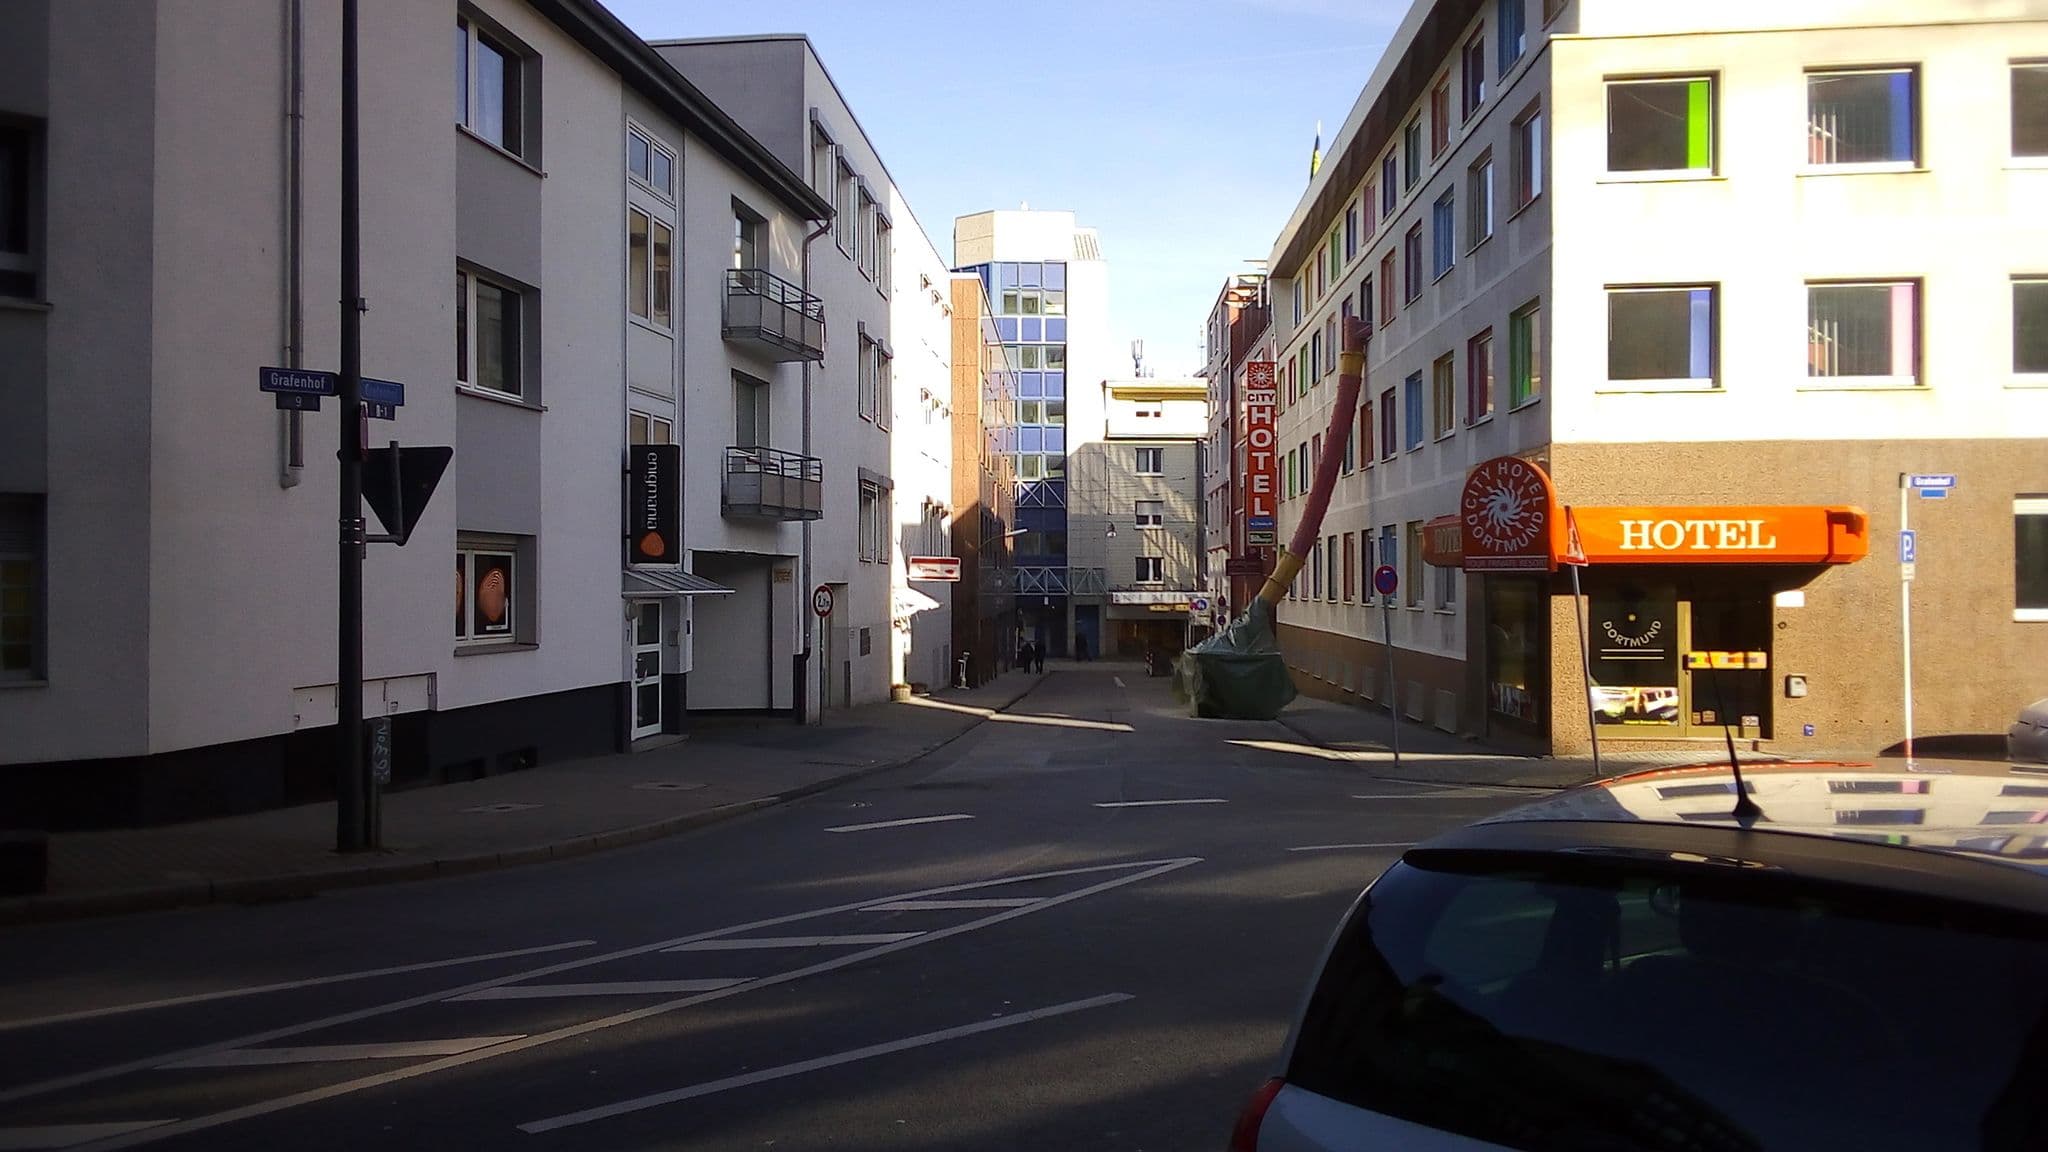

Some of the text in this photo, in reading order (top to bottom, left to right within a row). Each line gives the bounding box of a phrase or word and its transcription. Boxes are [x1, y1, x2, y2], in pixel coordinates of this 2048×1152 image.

[271, 372, 326, 390] Grafenhof
[295, 396, 301, 407] 9
[1247, 393, 1275, 402] CITY
[1250, 406, 1273, 516] HOTEL
[644, 452, 658, 529] enigmania
[1465, 462, 1545, 509] CITY HOTEL
[1466, 511, 1544, 553] DORTMUND
[1619, 519, 1777, 550] HOTEL
[1902, 534, 1913, 561] P
[1602, 620, 1662, 648] DORTMUND
